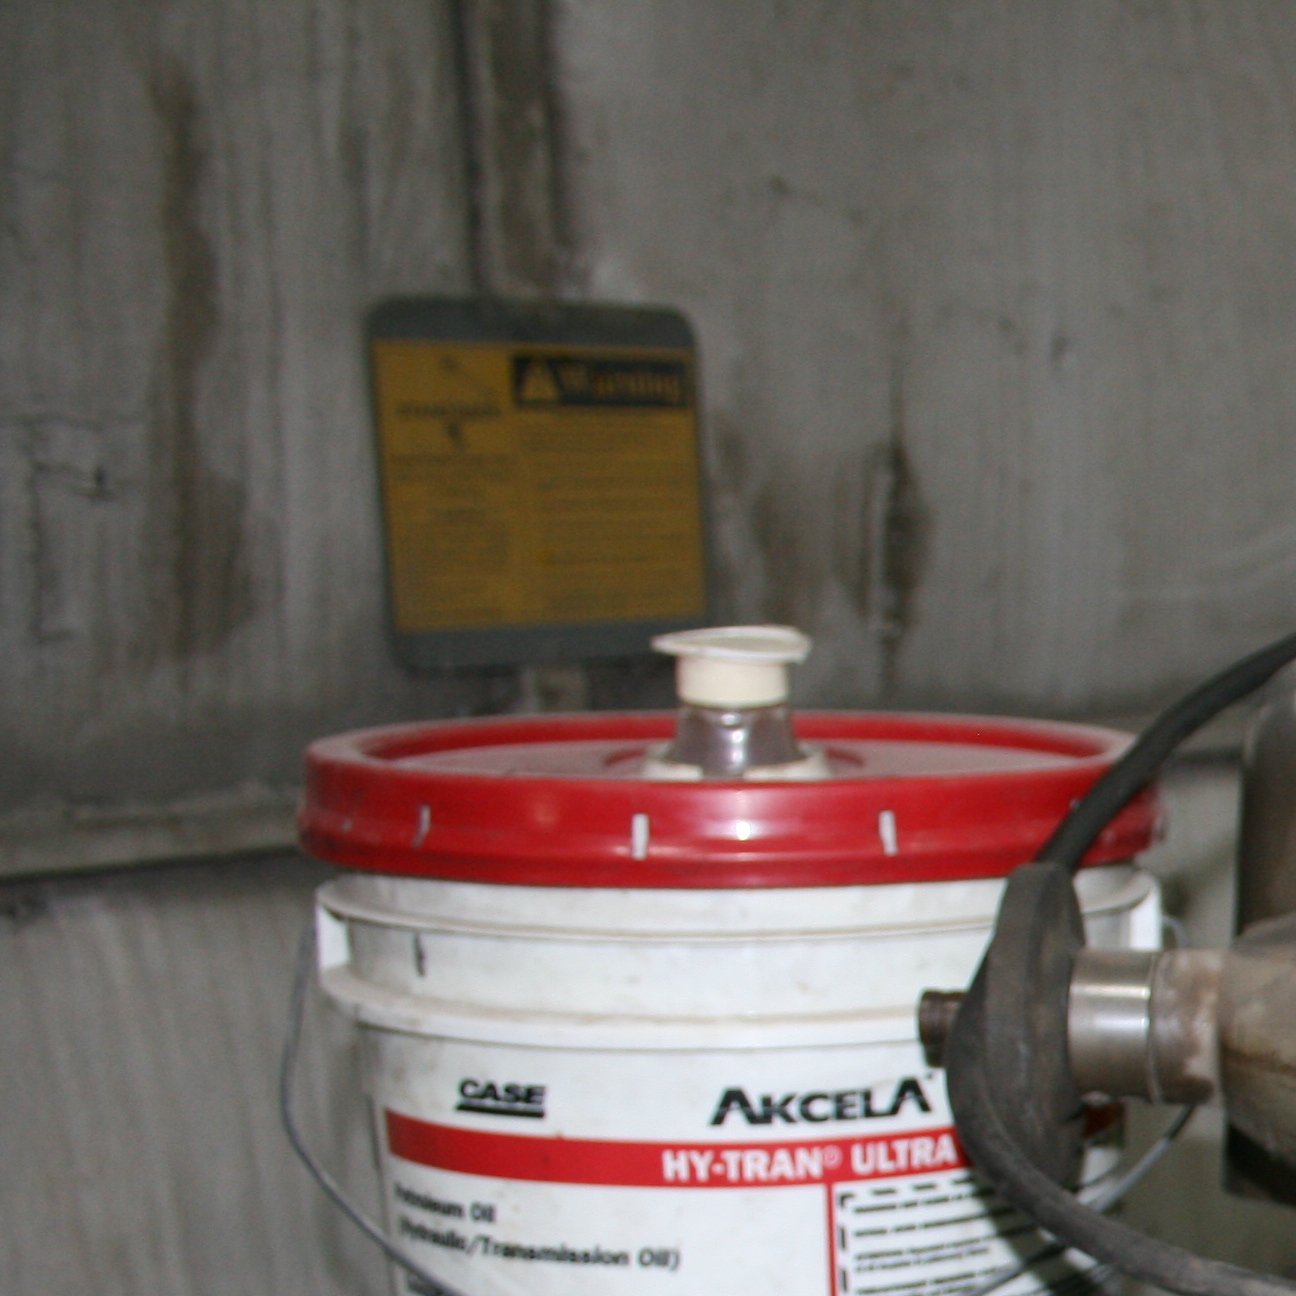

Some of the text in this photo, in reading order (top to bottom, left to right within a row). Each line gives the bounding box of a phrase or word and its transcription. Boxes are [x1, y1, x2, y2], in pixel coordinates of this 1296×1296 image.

[459, 1079, 547, 1106] CASE
[708, 1076, 932, 1126] AKCELA
[850, 1134, 958, 1175] ULTRA
[638, 1248, 680, 1270] Oil)
